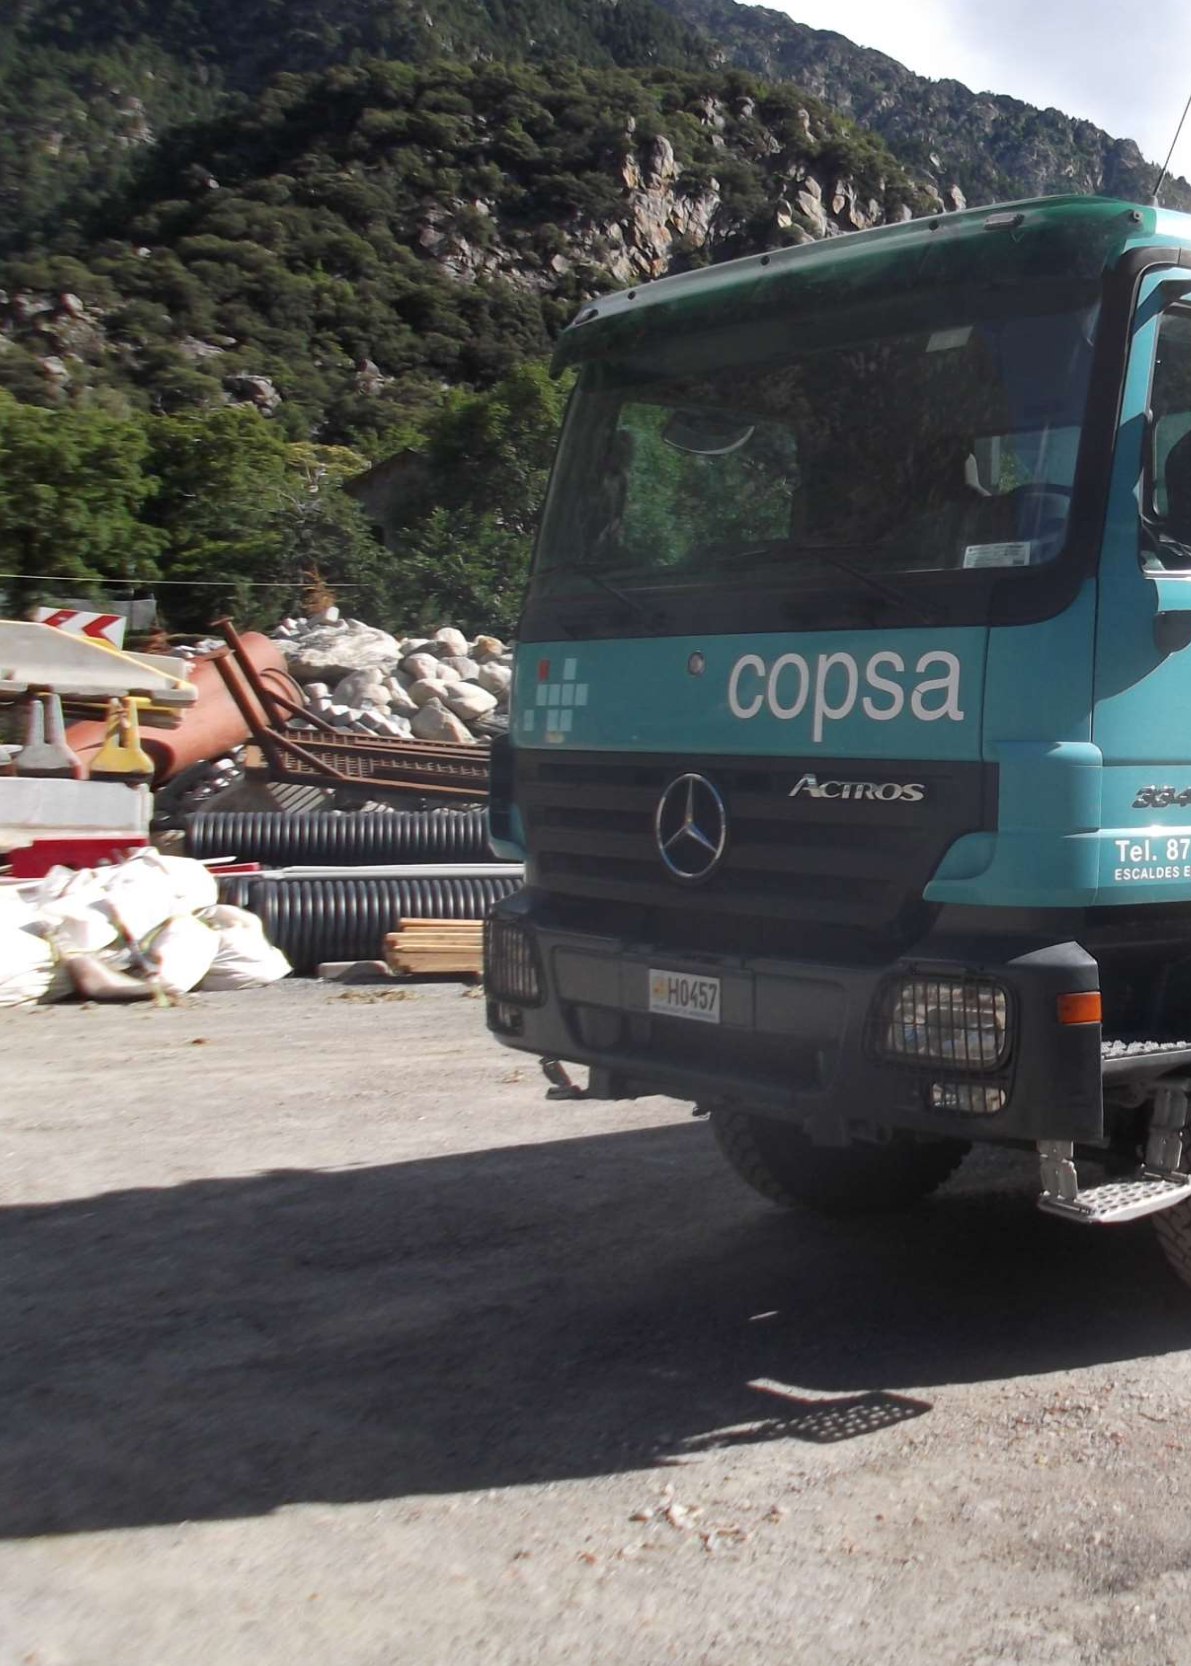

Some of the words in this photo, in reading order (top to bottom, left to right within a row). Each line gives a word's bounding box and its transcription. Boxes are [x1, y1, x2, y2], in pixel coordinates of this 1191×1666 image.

[728, 651, 965, 742] copsa
[1115, 838, 1157, 862] Tel.
[1166, 838, 1191, 861] 87
[1114, 866, 1180, 881] ESCALDES
[667, 977, 718, 1012] H0457
